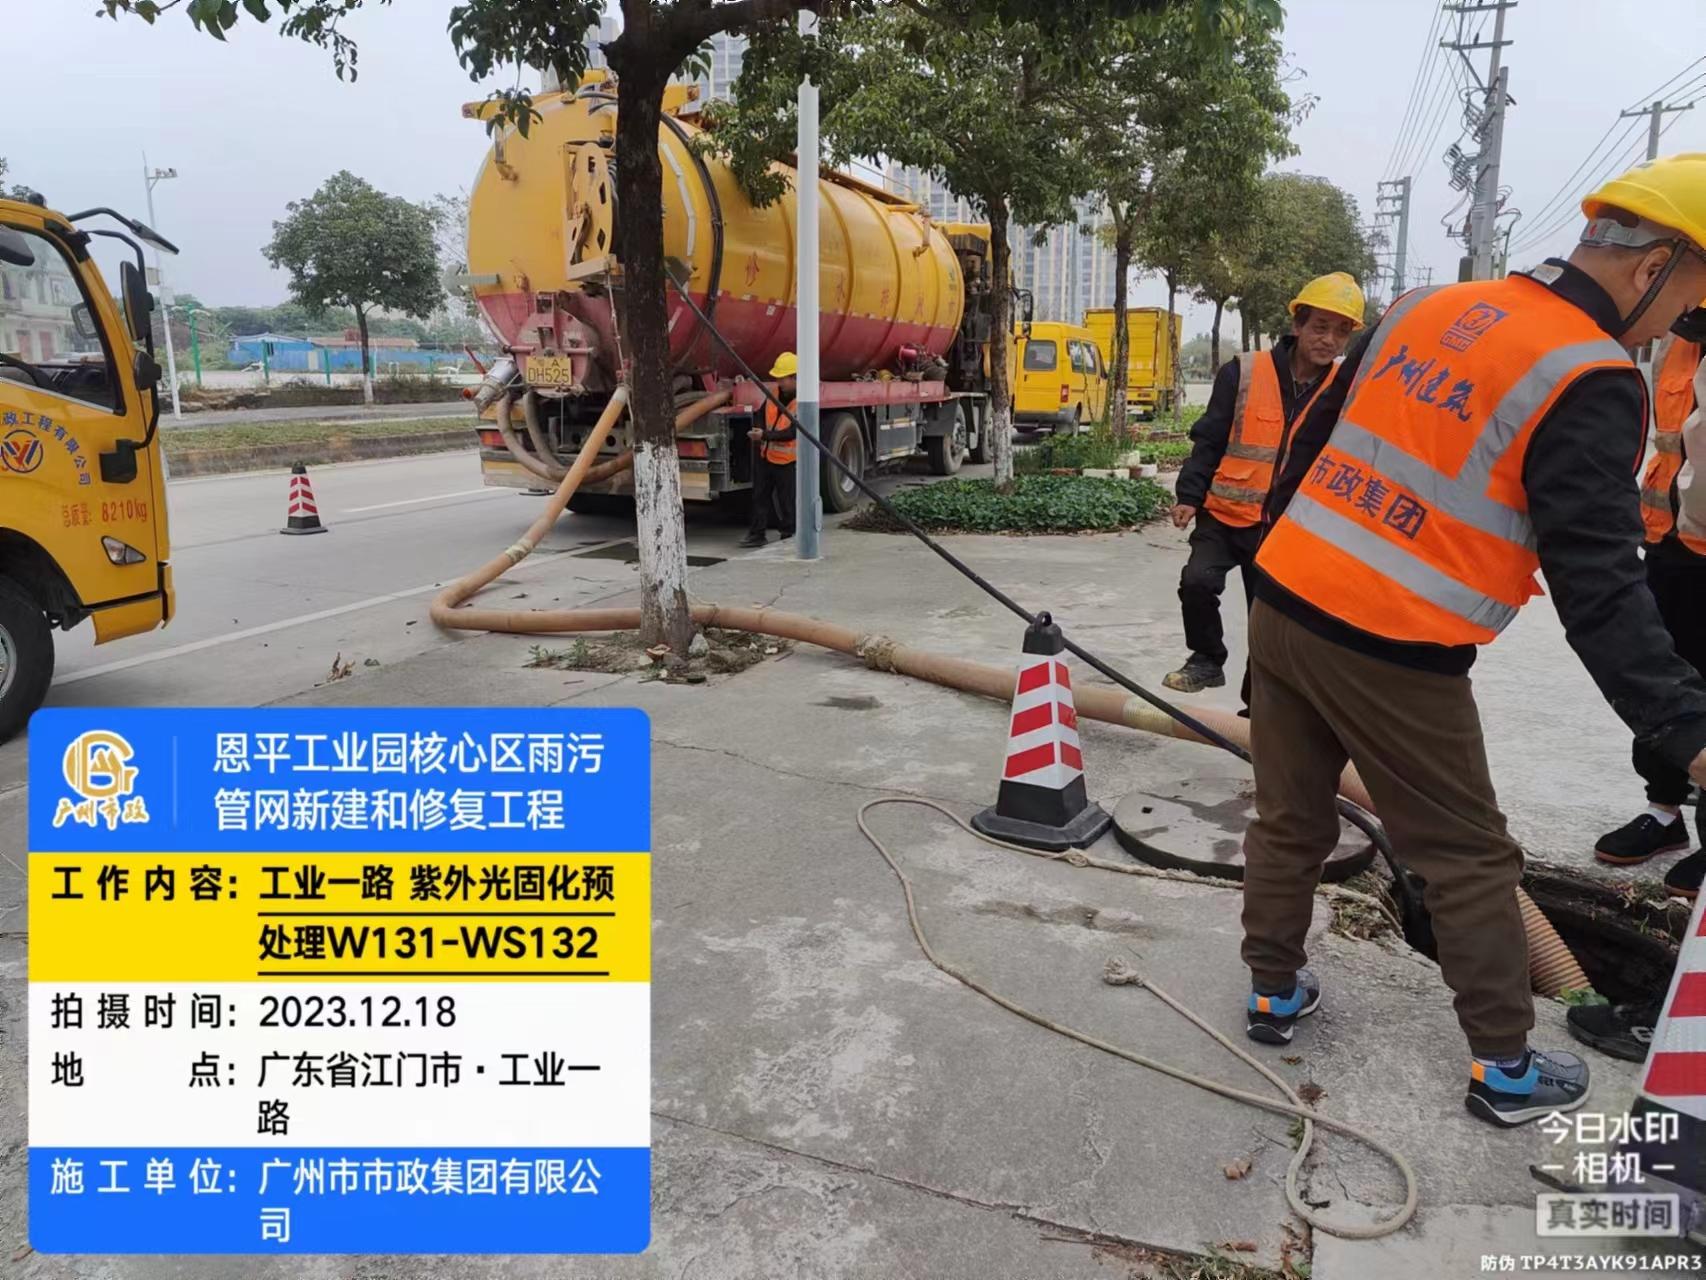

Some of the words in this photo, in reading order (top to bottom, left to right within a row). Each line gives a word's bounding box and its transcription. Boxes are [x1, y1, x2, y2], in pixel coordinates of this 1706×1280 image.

[528, 367, 570, 383] DH525
[1310, 455, 1428, 540] 市政集团
[102, 499, 147, 522] 8210kg
